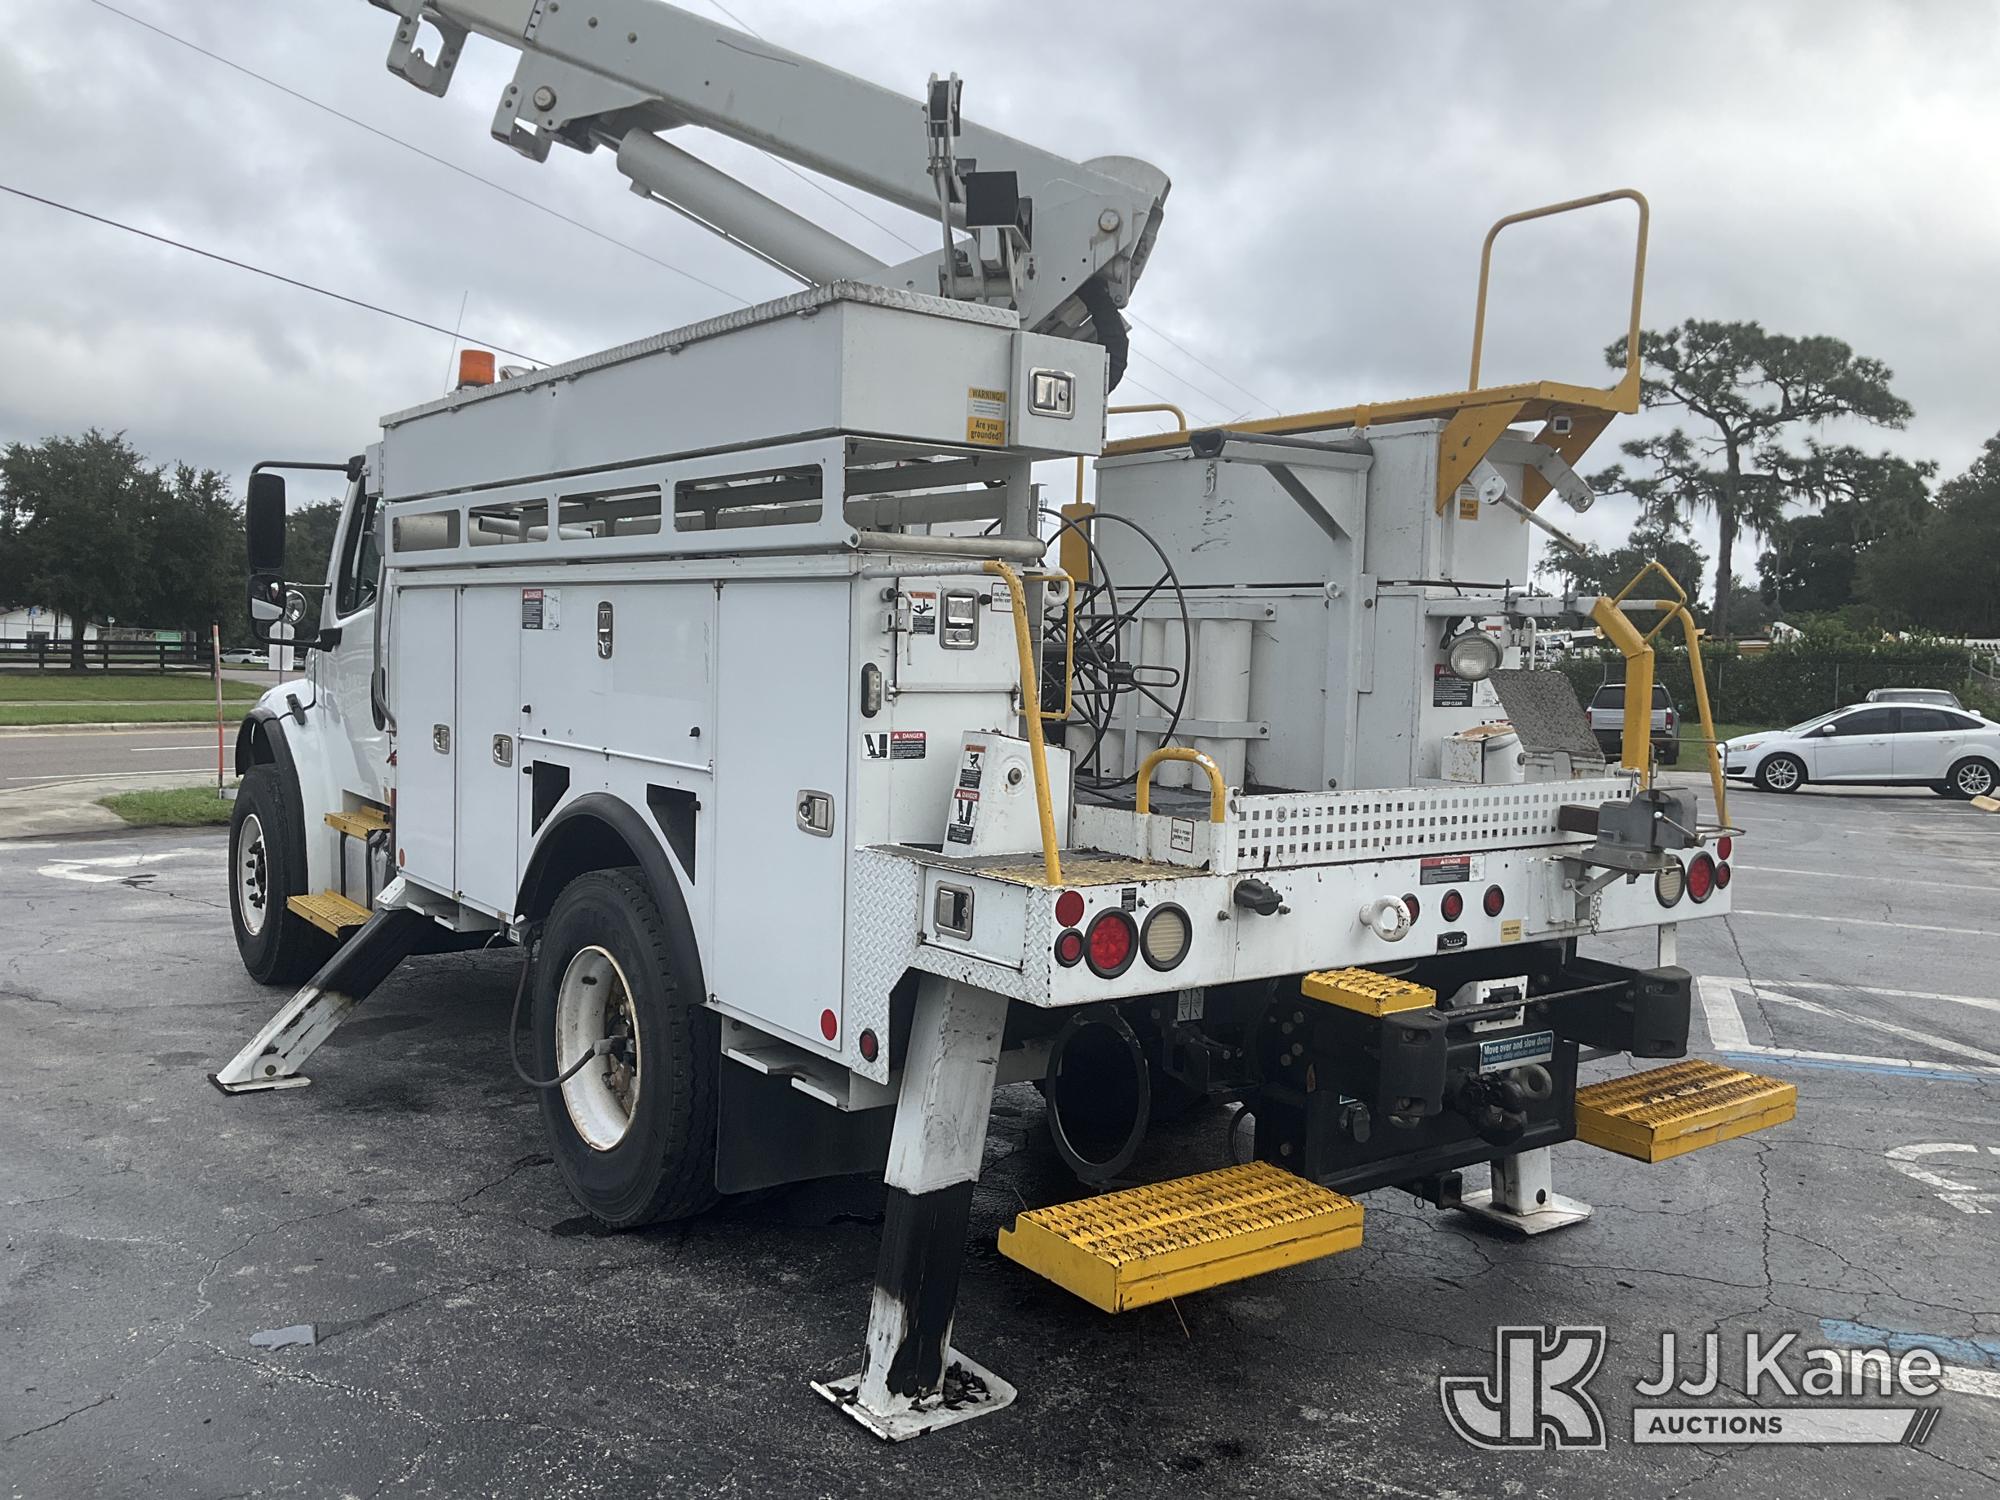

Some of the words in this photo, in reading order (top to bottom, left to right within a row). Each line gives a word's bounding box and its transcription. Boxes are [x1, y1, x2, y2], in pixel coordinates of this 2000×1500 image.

[1484, 1045, 1499, 1055] Move
[1500, 1043, 1512, 1053] over
[1513, 1040, 1523, 1050] and
[1523, 1038, 1536, 1048] slow
